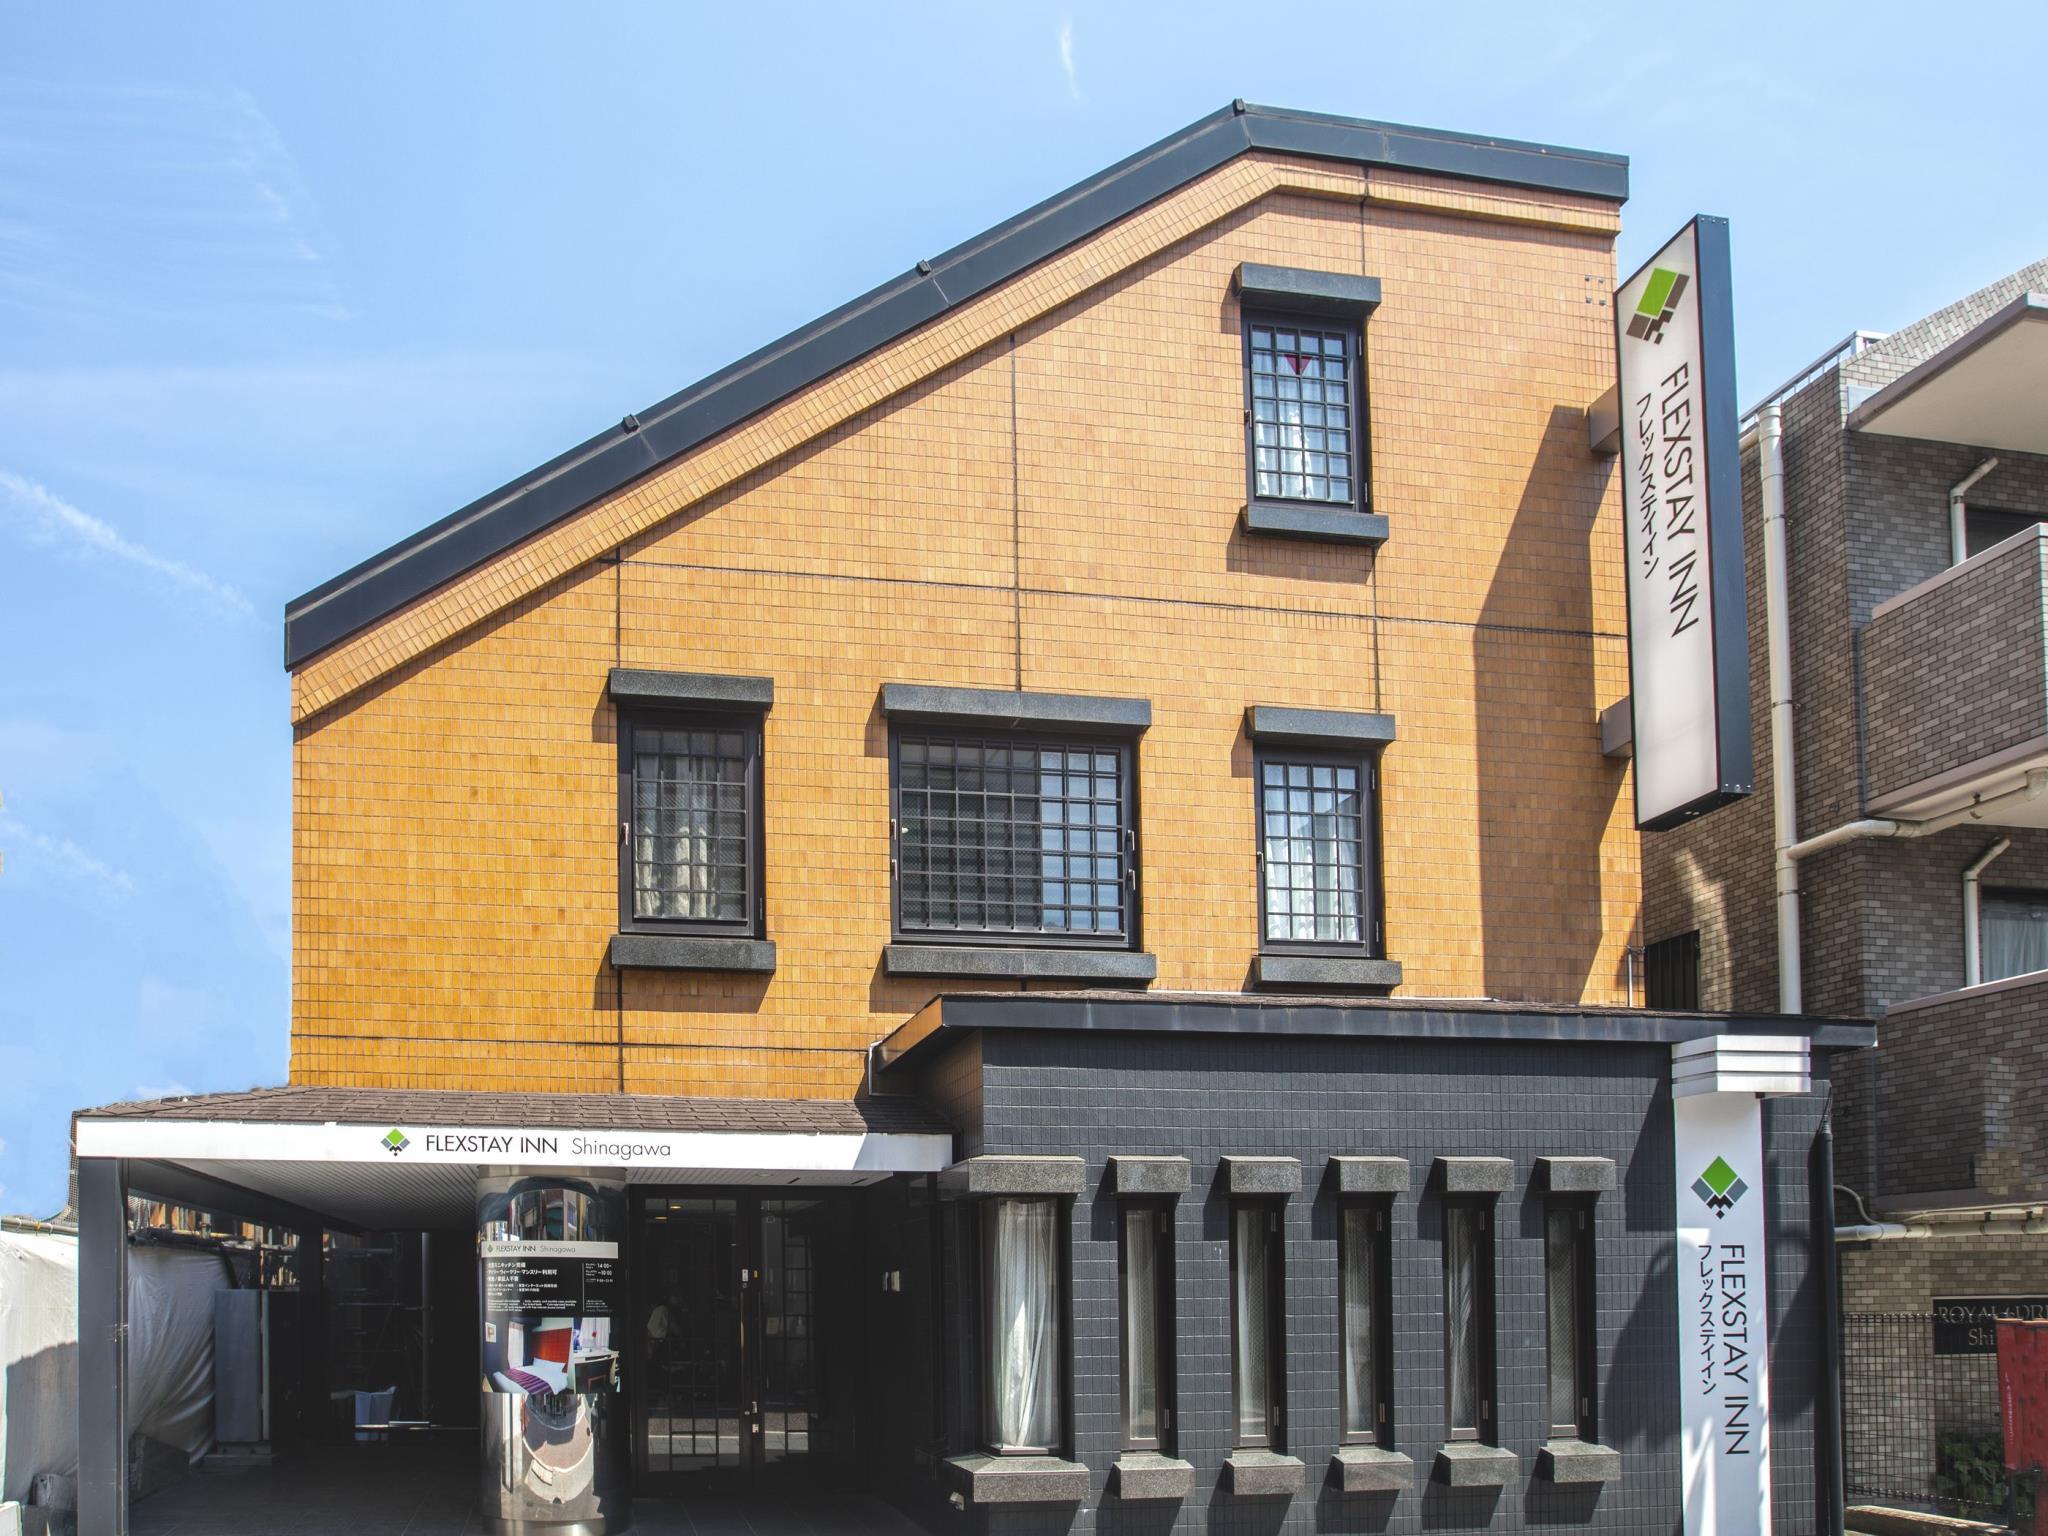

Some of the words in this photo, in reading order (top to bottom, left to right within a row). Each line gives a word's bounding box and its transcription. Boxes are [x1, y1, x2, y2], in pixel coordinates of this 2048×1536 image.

[1636, 392, 1659, 579] フレックステイイン
[1661, 361, 1695, 541] FLEXSTAY
[1668, 549, 1699, 638] INN
[426, 1134, 513, 1153] FLEXSTAY
[520, 1137, 558, 1154] INN
[572, 1137, 671, 1160] Shinagawa
[496, 1245, 521, 1253] FLEXSTAY
[522, 1245, 536, 1253] INN
[540, 1245, 576, 1254] Shinagawa
[1698, 1245, 1716, 1395] フレックステイイン
[1720, 1244, 1748, 1384] FLEXSTAY
[1938, 1306, 1999, 1323] ROYAL
[1968, 1328, 1995, 1346] Shi
[1724, 1396, 1750, 1455] INN
